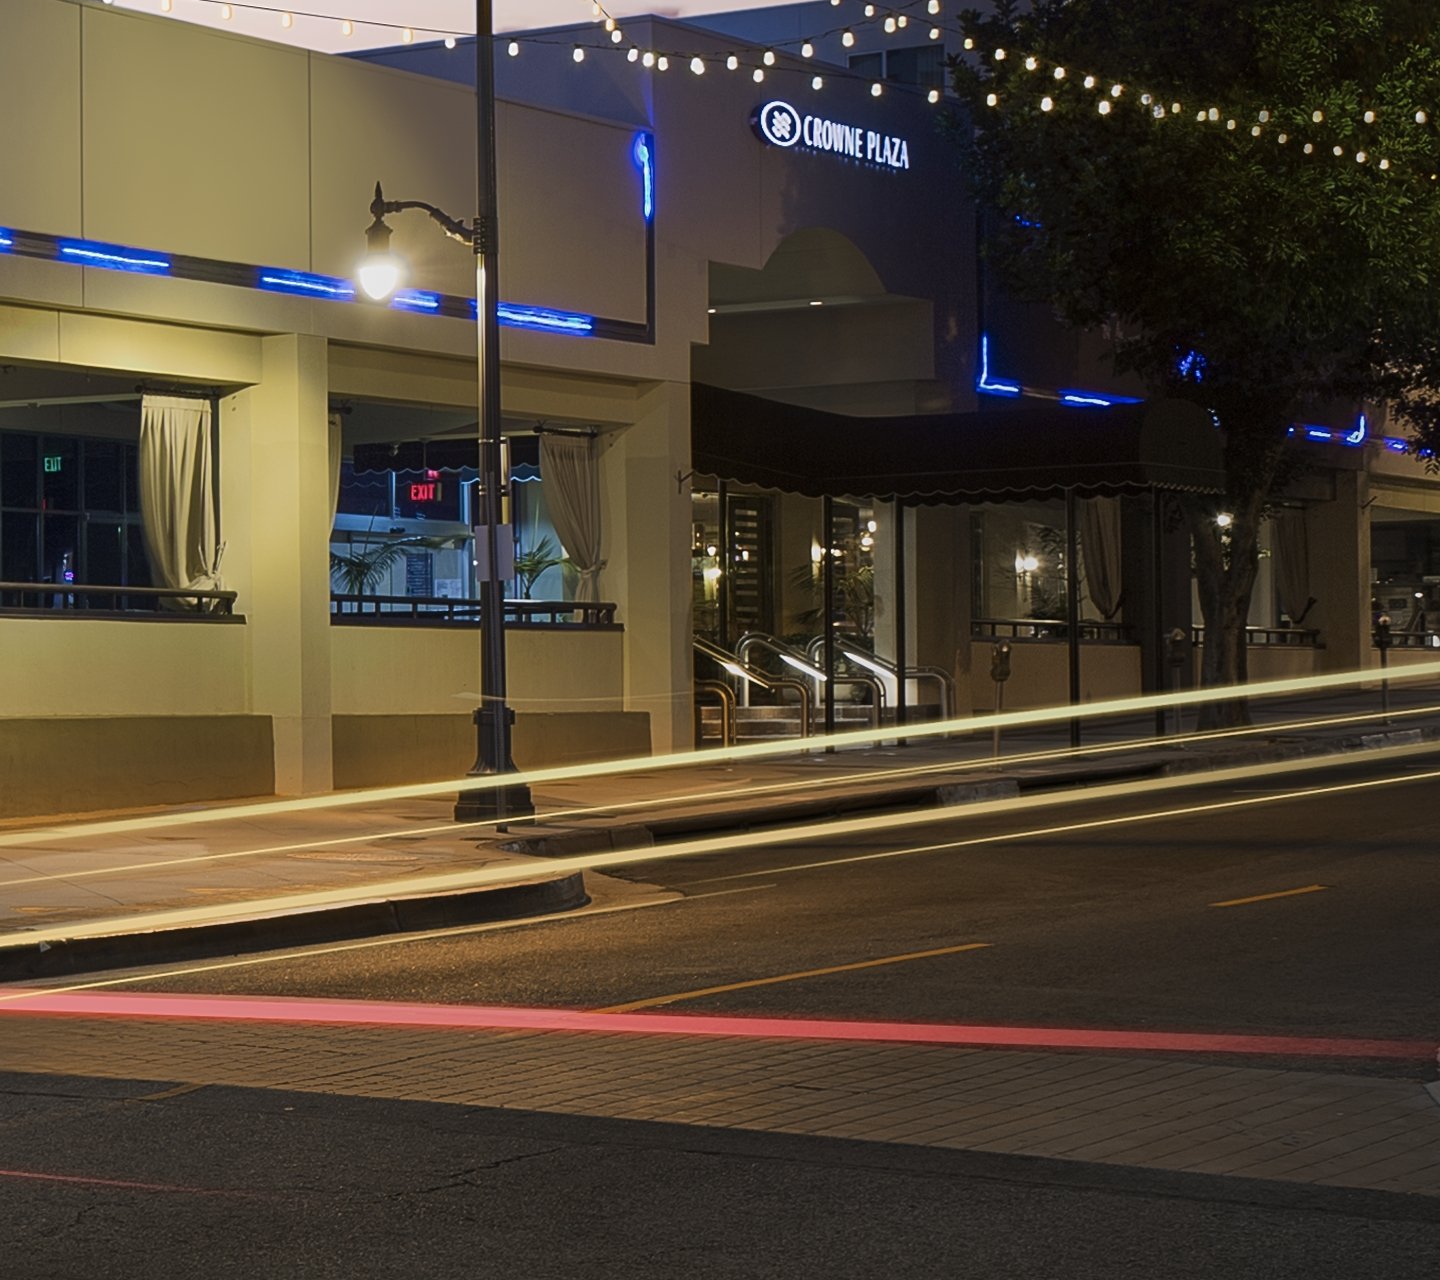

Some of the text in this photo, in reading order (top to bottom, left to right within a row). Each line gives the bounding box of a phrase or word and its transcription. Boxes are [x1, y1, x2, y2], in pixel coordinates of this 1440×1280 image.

[803, 115, 909, 169] CROWNE PLAZA
[411, 483, 435, 501] EXIT
